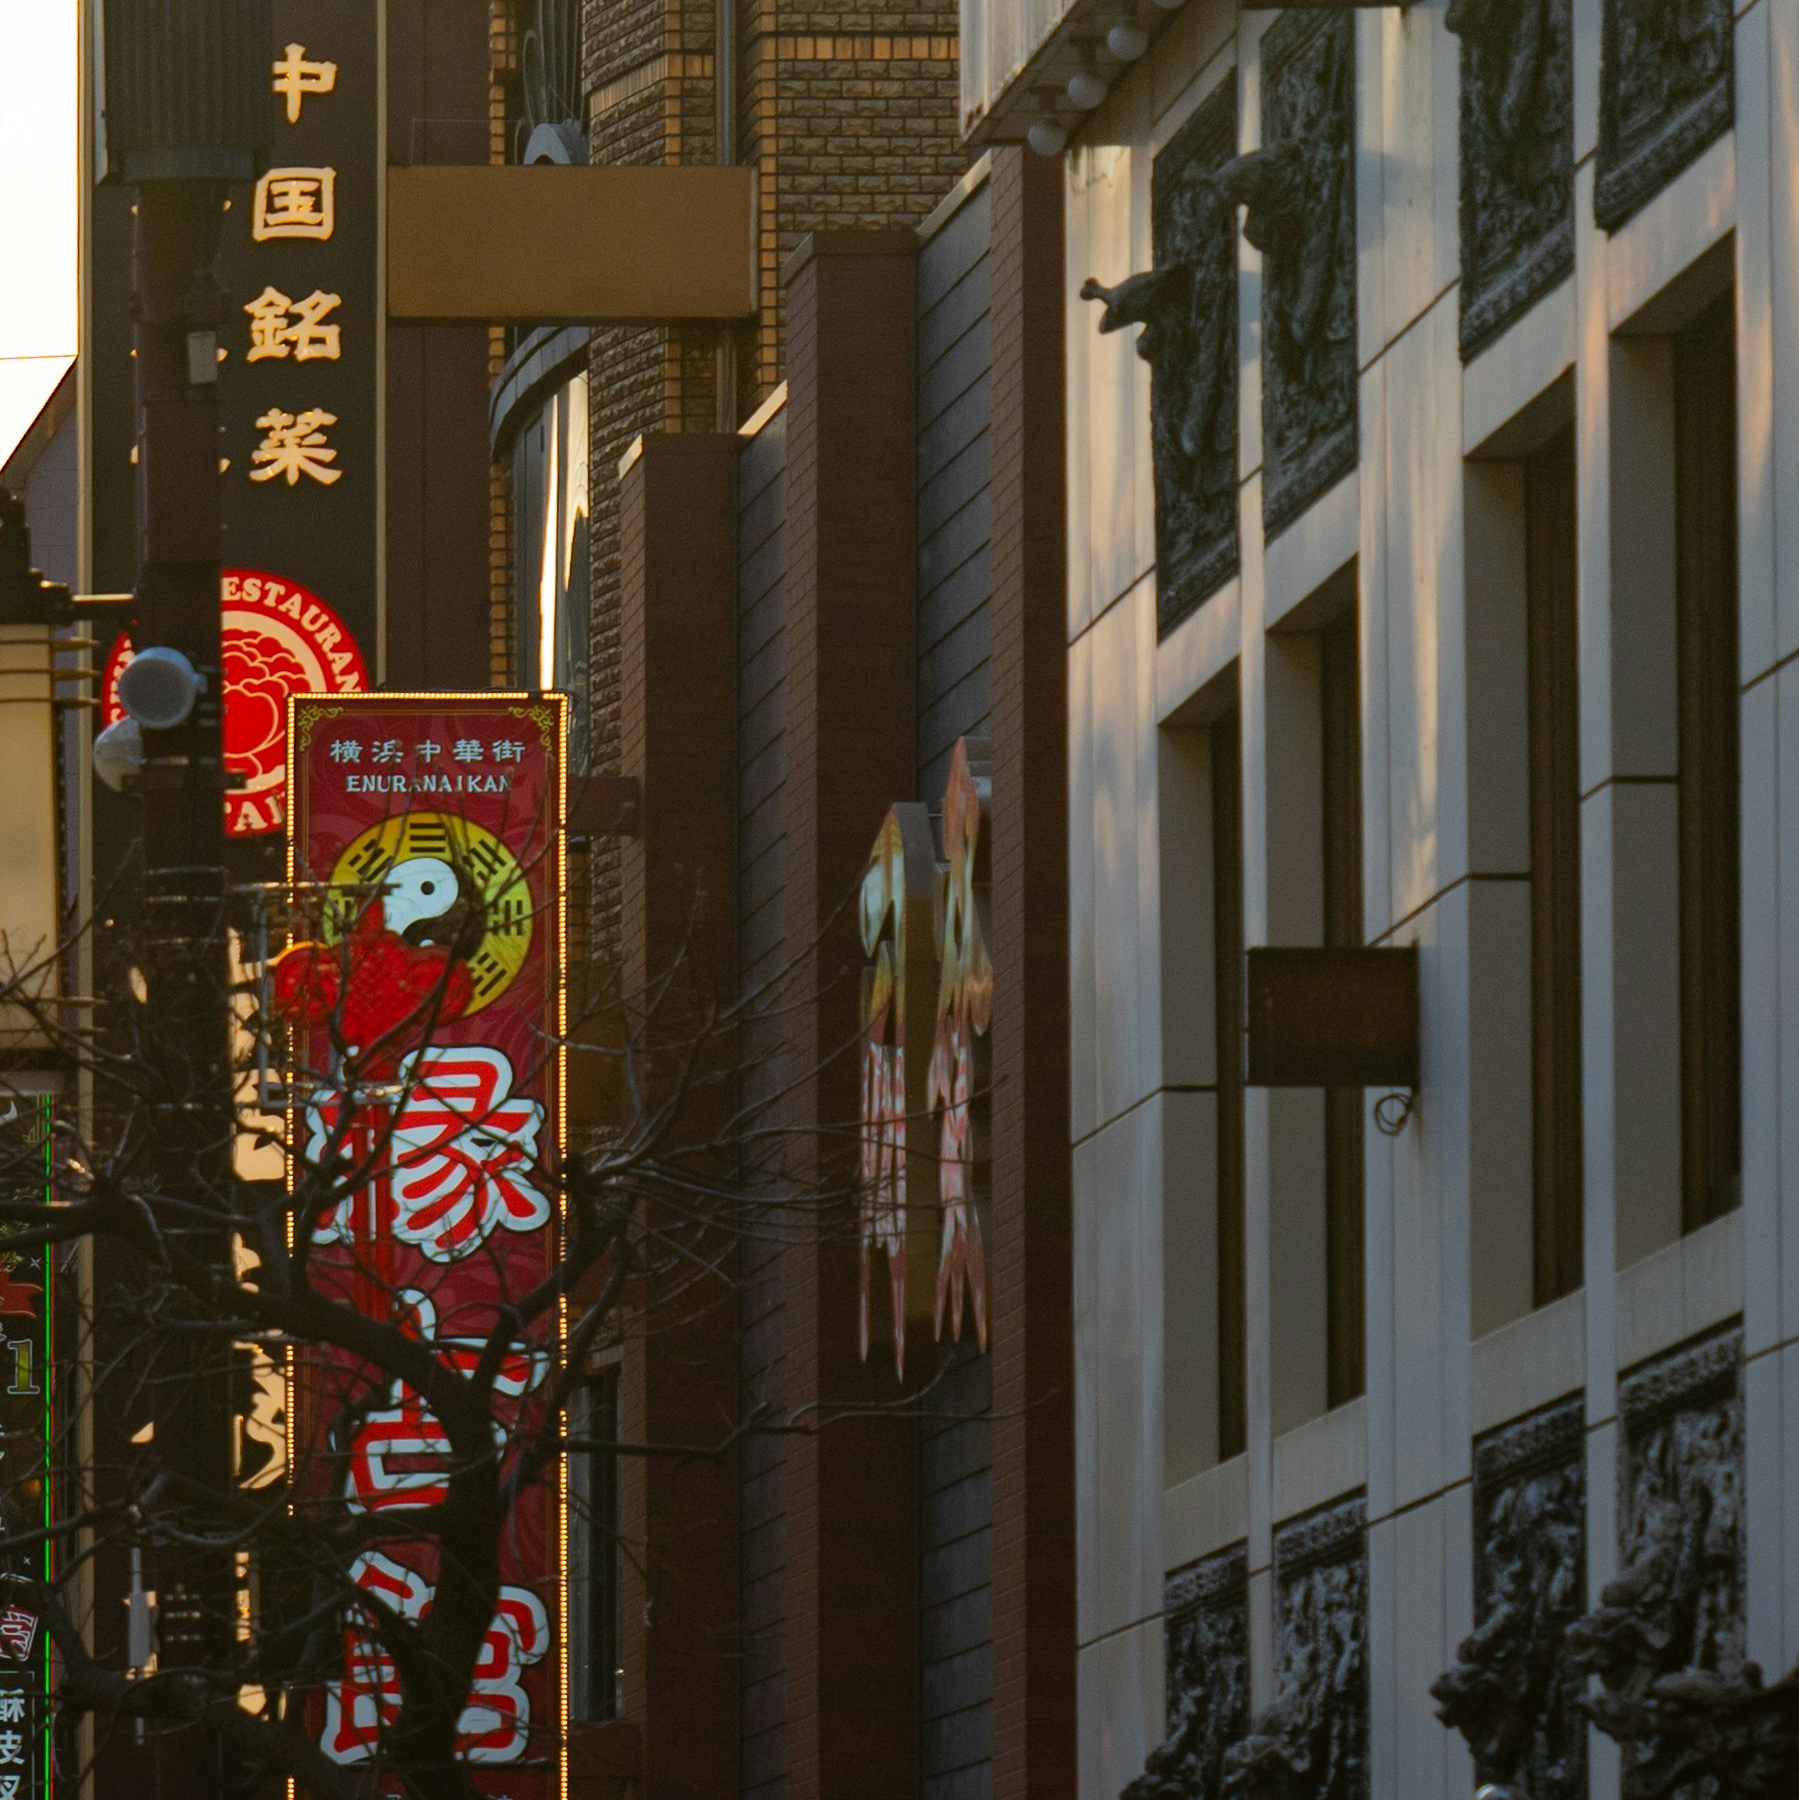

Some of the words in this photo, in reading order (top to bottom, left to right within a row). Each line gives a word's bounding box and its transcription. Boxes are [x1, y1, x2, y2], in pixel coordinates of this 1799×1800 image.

[241, 42, 344, 486] 中国銘菜
[221, 576, 363, 692] ESTAURAN
[330, 738, 526, 764] 横浜中華街
